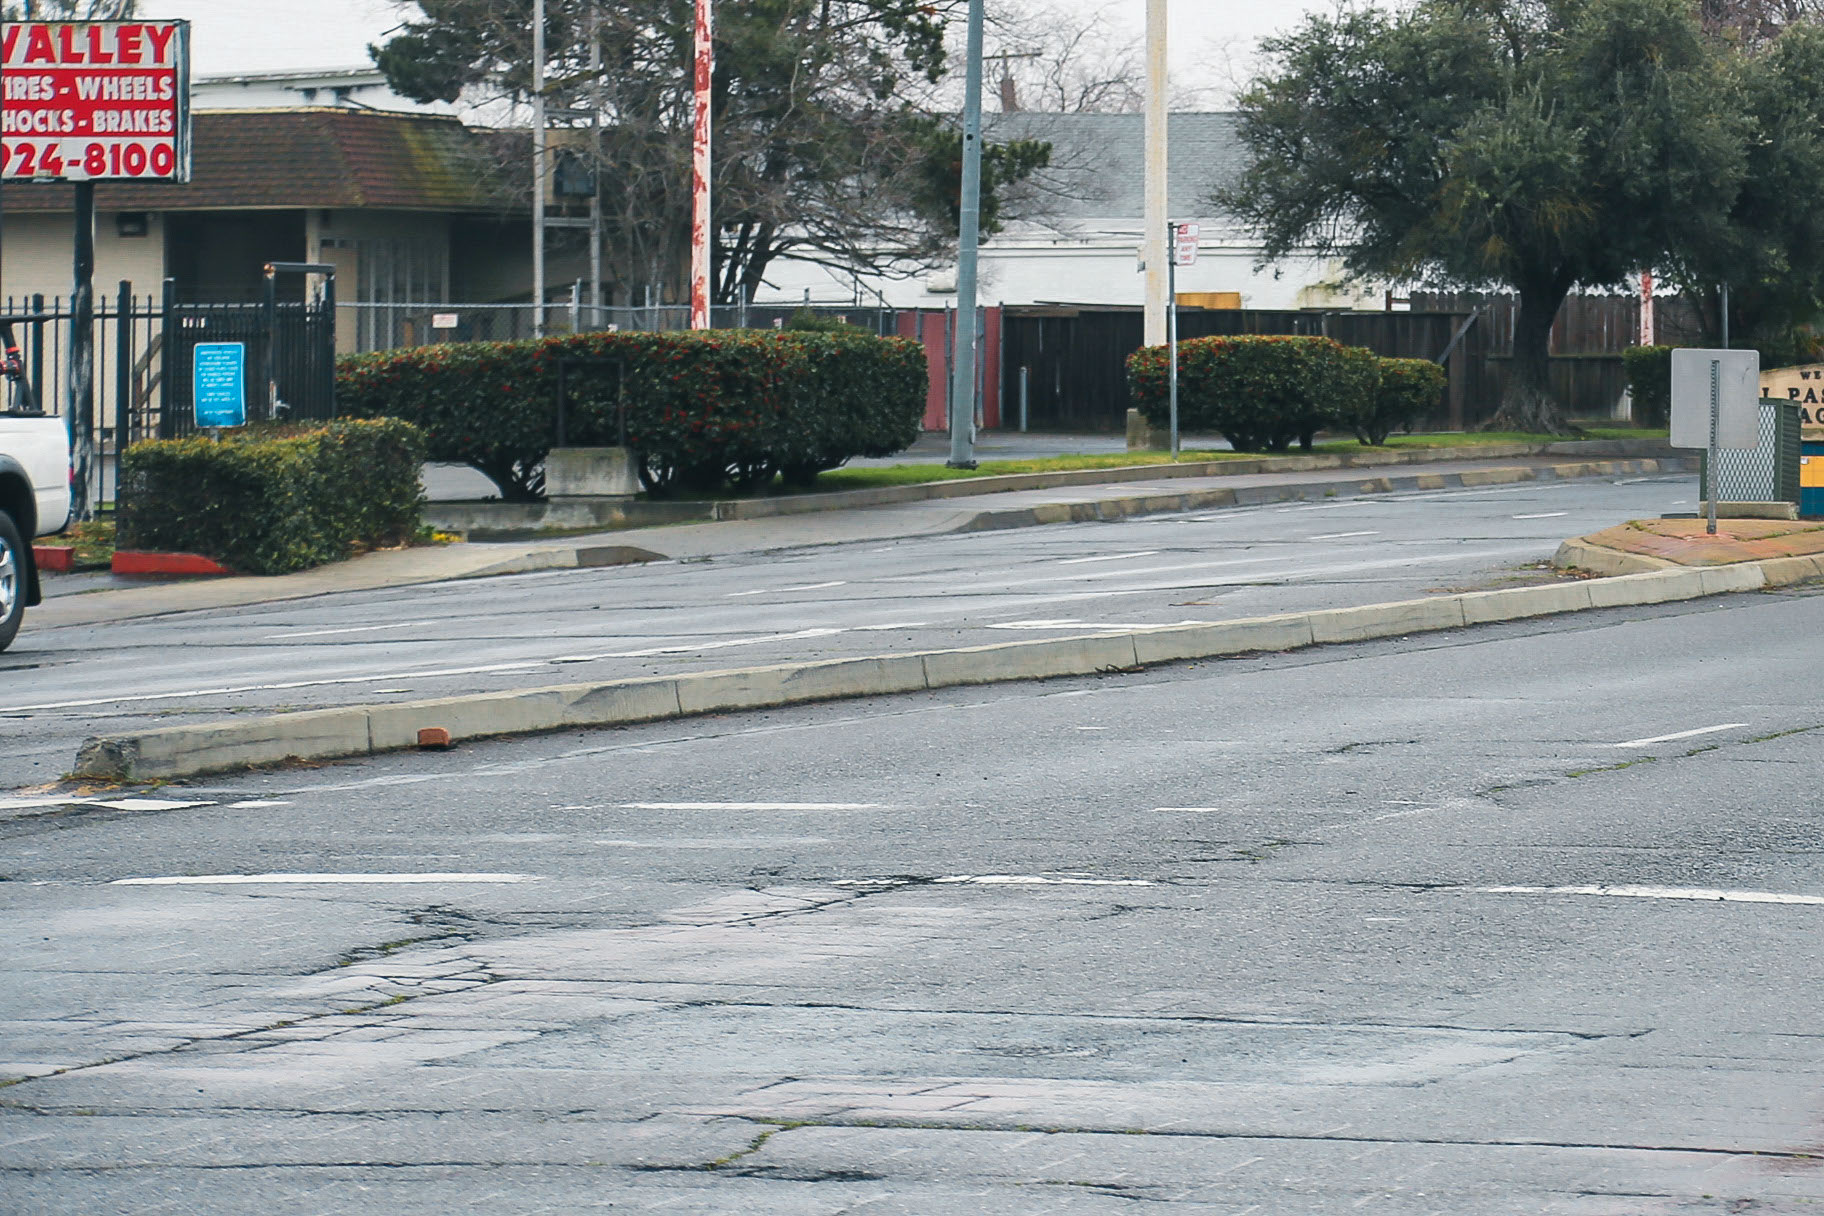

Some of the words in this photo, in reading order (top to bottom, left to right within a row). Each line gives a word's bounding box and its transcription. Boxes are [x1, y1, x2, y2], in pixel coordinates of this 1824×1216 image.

[2, 25, 175, 63] VALLEY
[1, 75, 55, 101] IRES
[75, 75, 172, 100] WHEELS
[92, 109, 172, 132] BRAKES
